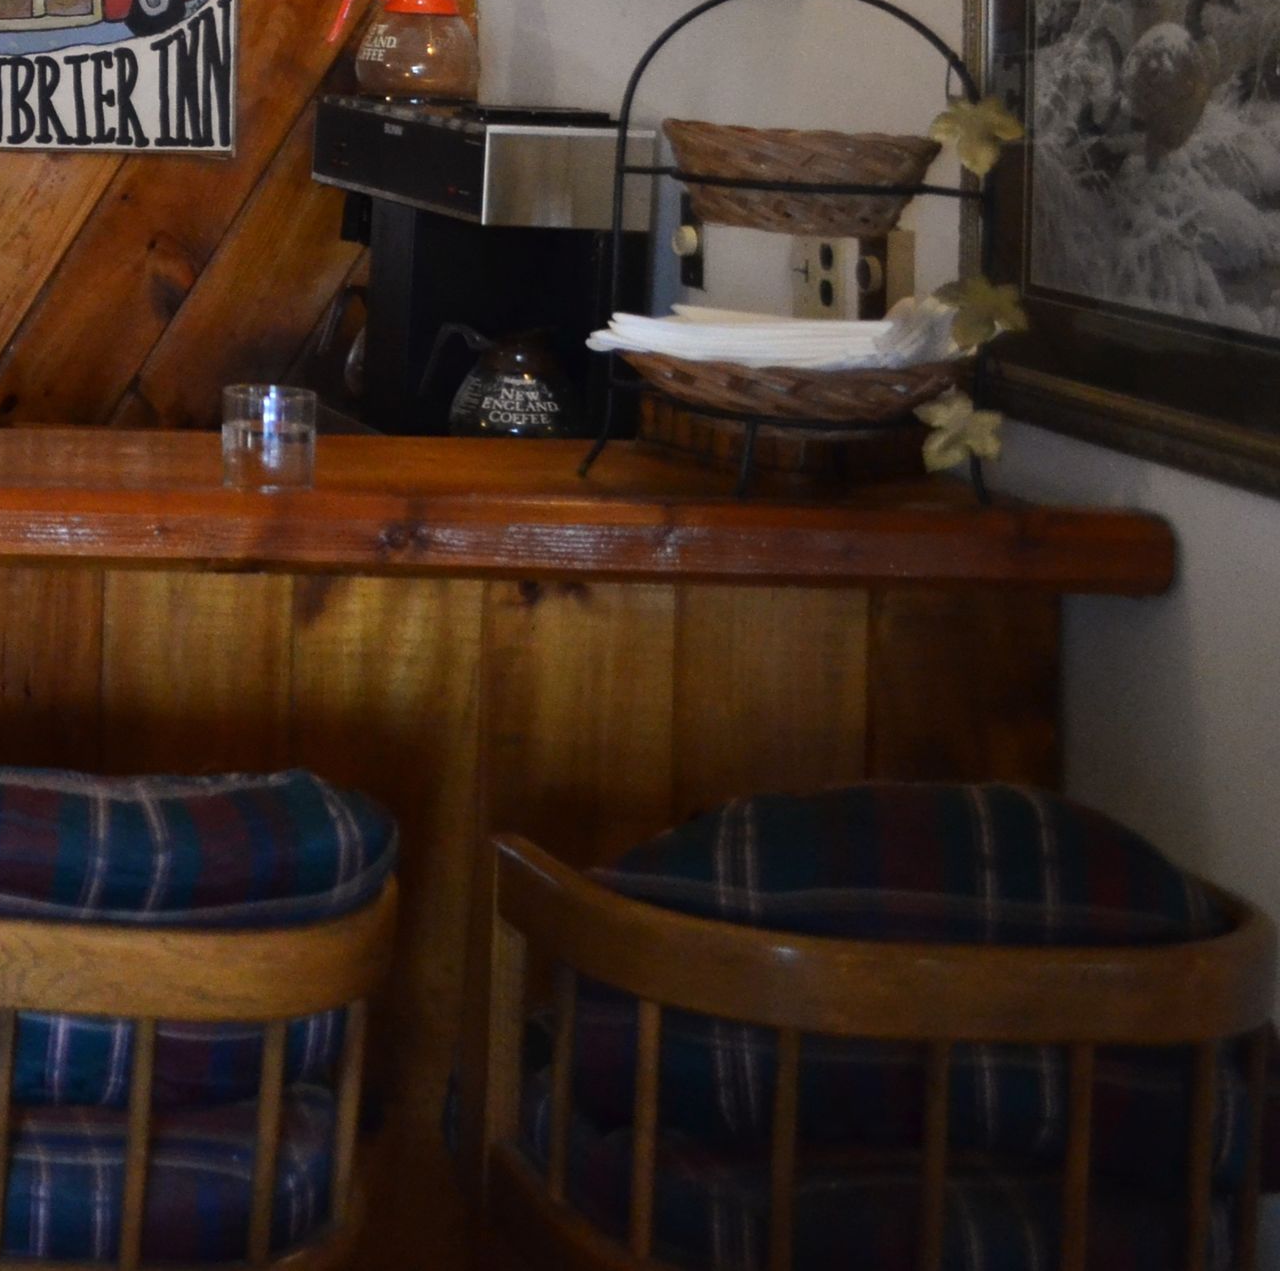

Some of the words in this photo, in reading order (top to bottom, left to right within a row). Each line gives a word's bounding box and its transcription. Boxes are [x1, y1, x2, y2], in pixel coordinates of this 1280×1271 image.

[500, 388, 539, 401] NEW
[481, 397, 560, 413] ENGLAND
[488, 410, 551, 425] COFFEE
